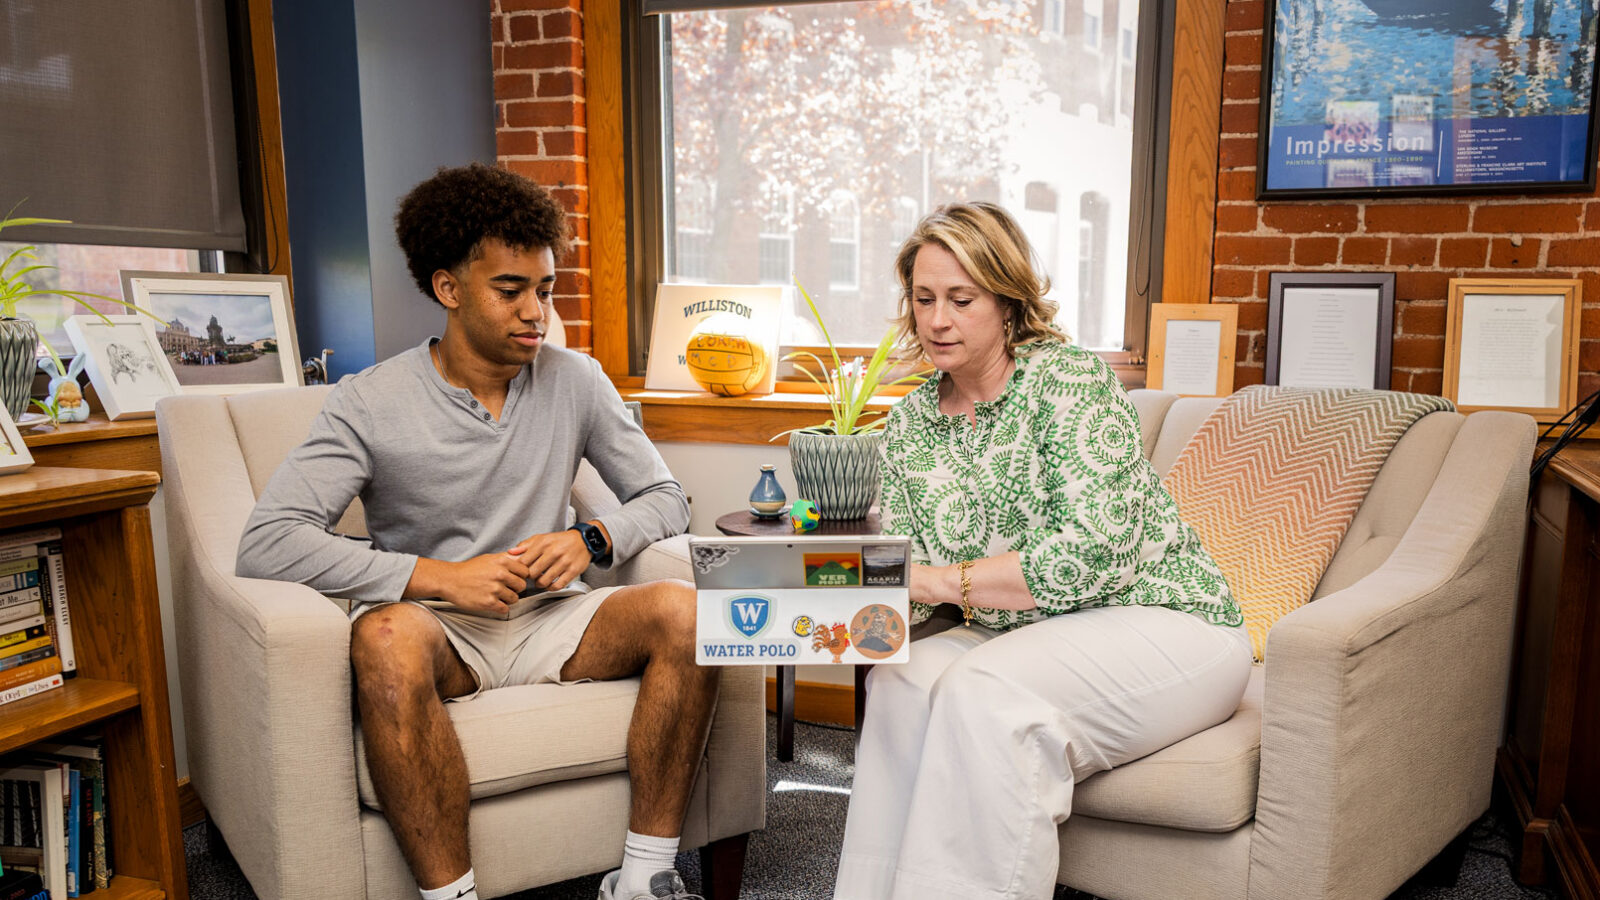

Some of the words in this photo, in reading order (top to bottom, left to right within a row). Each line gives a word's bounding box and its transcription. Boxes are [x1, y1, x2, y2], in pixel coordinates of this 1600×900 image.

[1287, 132, 1424, 158] Impression
[683, 299, 752, 319] WILLISTON
[58, 585, 66, 605] BEACH
[734, 603, 766, 624] W
[704, 645, 755, 657] WATER
[759, 644, 796, 657] POLO
